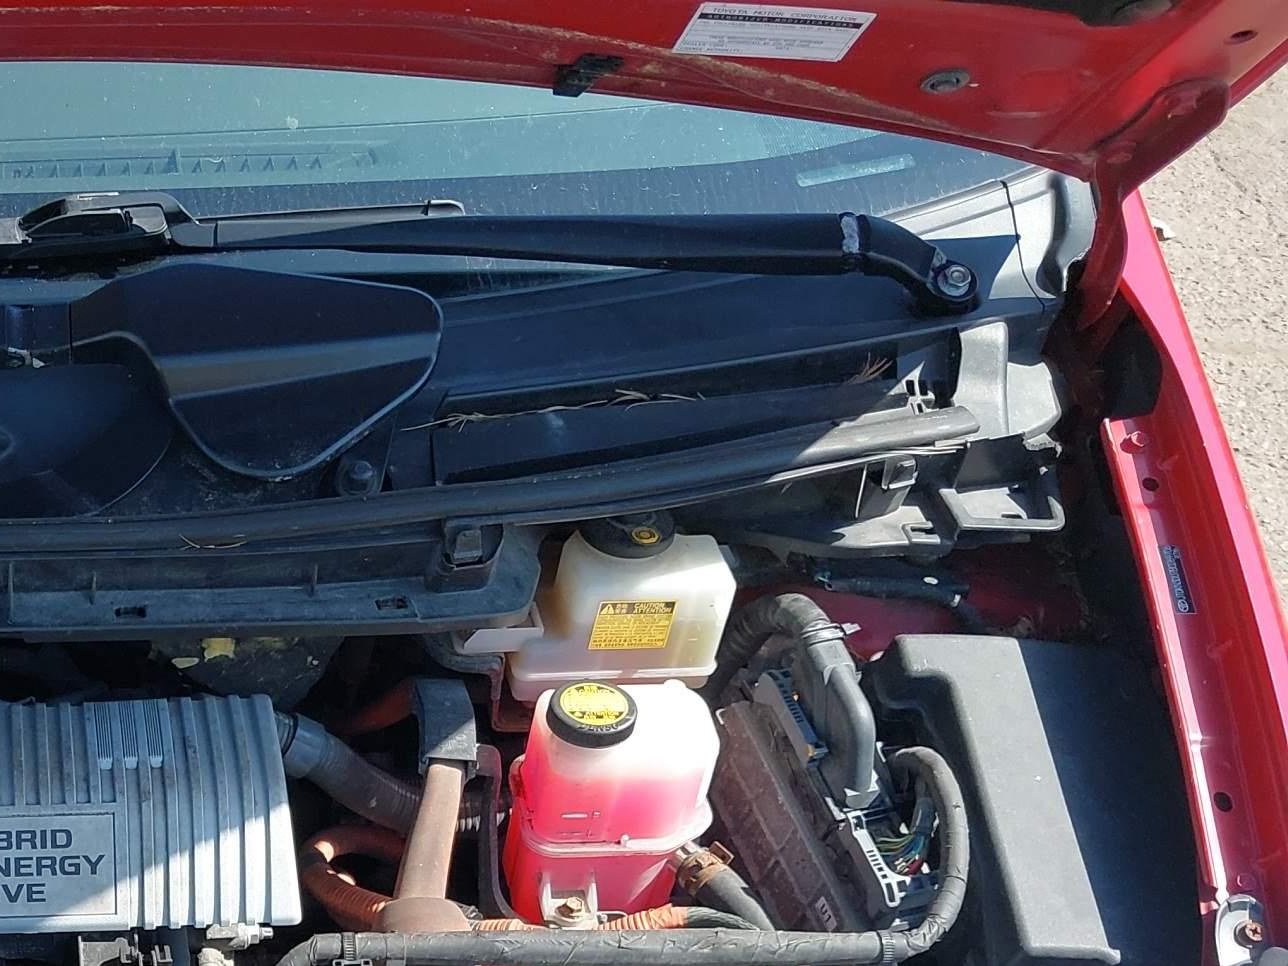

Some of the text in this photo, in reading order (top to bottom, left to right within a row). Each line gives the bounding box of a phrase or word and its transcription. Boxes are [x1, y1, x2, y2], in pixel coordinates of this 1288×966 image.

[713, 7, 857, 22] TOYOTA MOTOR CORPORATION
